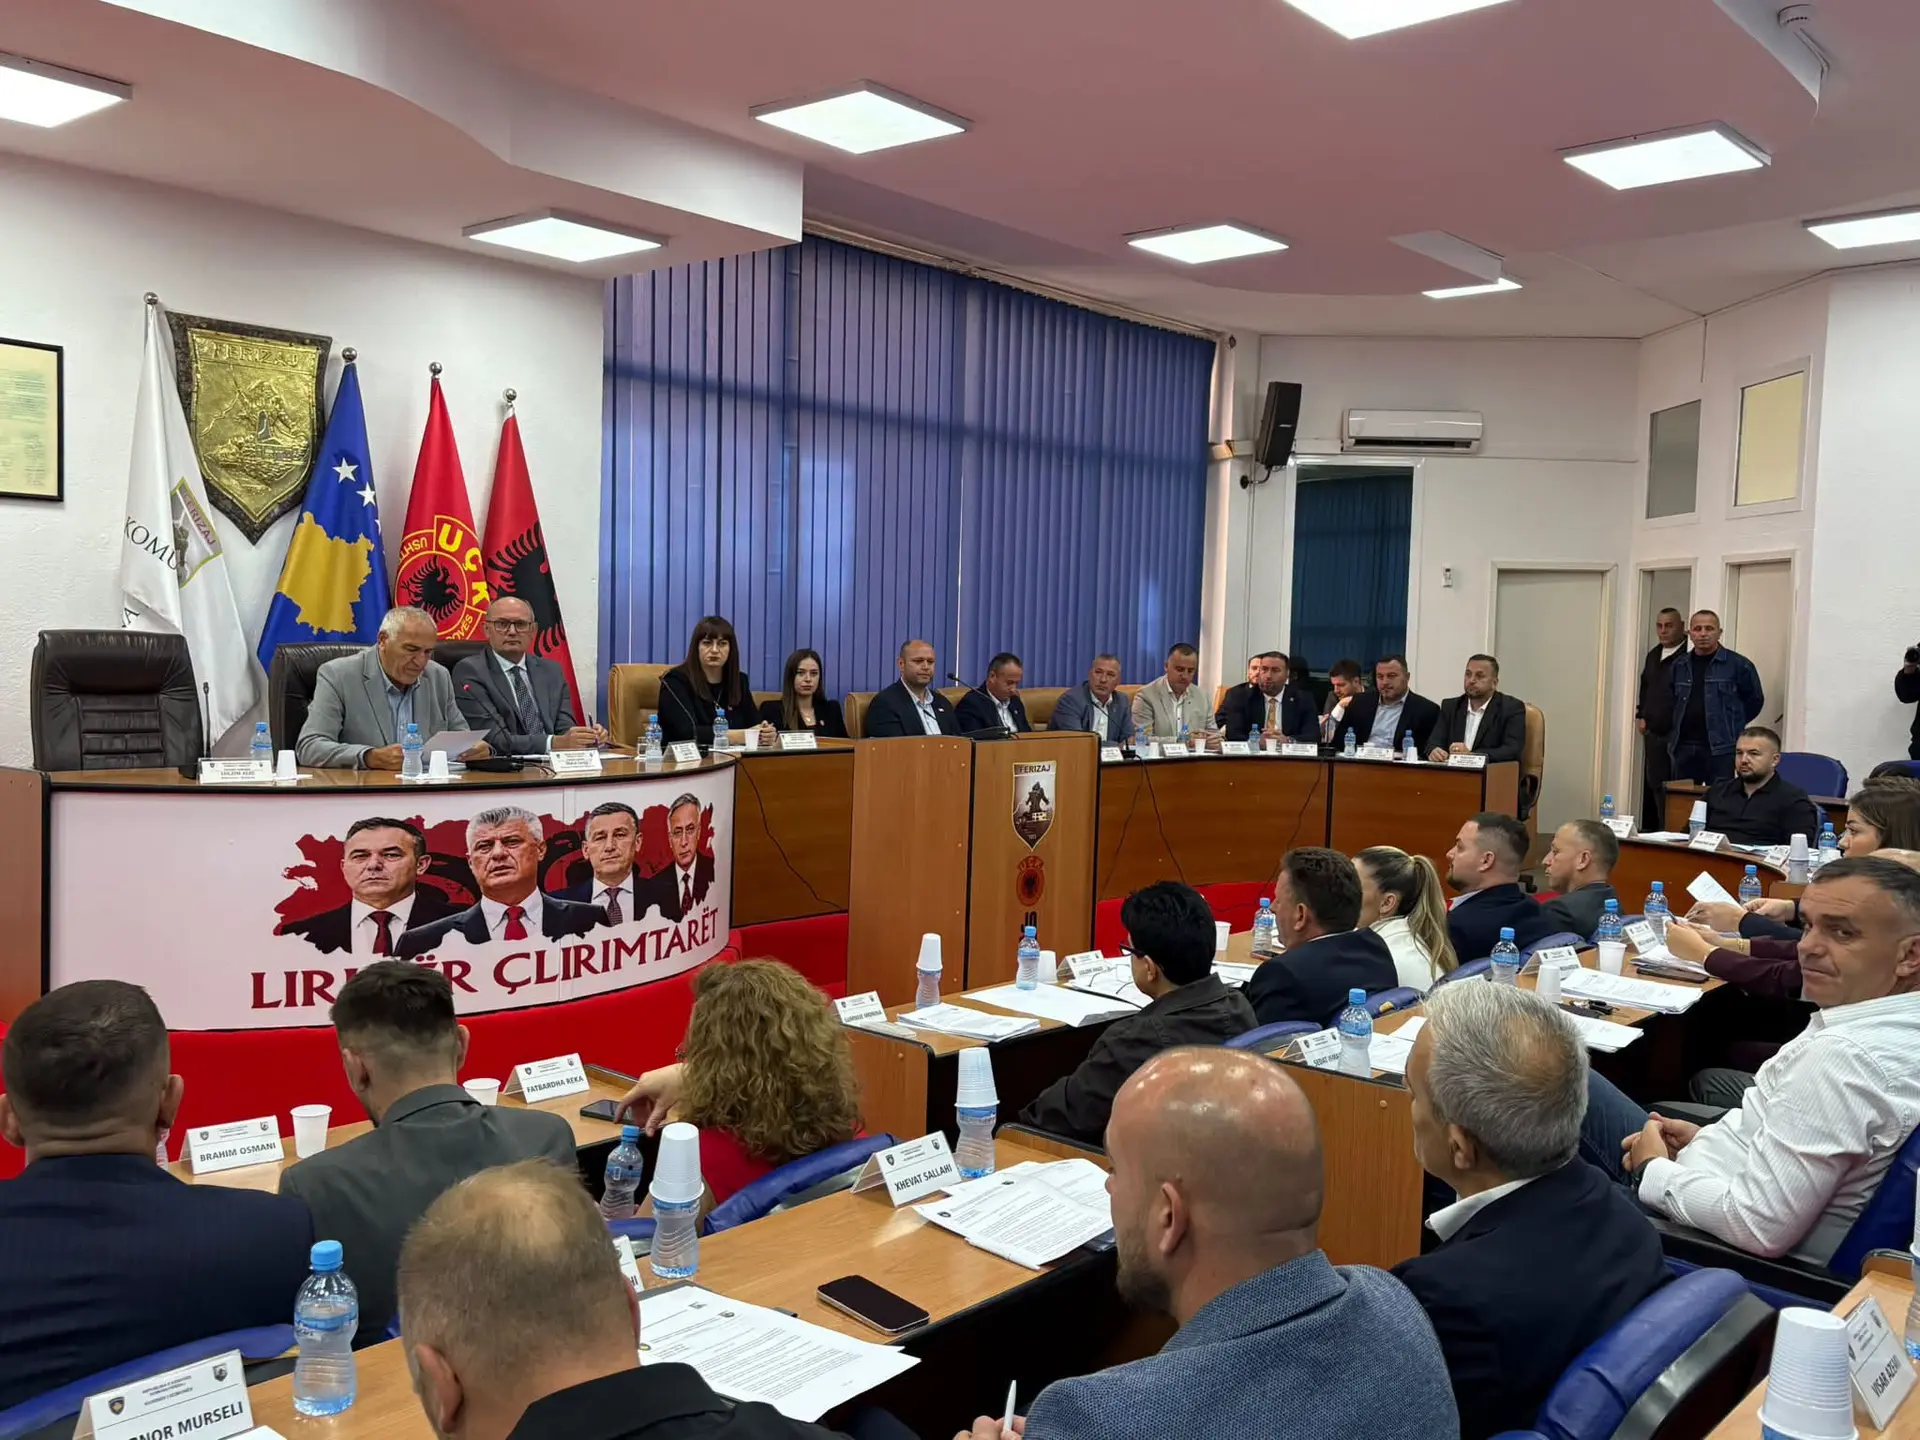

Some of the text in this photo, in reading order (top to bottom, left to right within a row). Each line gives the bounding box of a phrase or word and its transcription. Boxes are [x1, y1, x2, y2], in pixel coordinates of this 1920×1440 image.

[1019, 764, 1051, 774] FERIZAJ
[493, 907, 719, 995] ÇLIRIMTARËT
[526, 1075, 585, 1094] FATBARDHA REKA
[200, 1141, 277, 1162] BRAHIM OSMANI
[894, 1163, 953, 1192] XHEVAT SALLAHI
[177, 1400, 244, 1435] MURSELI
